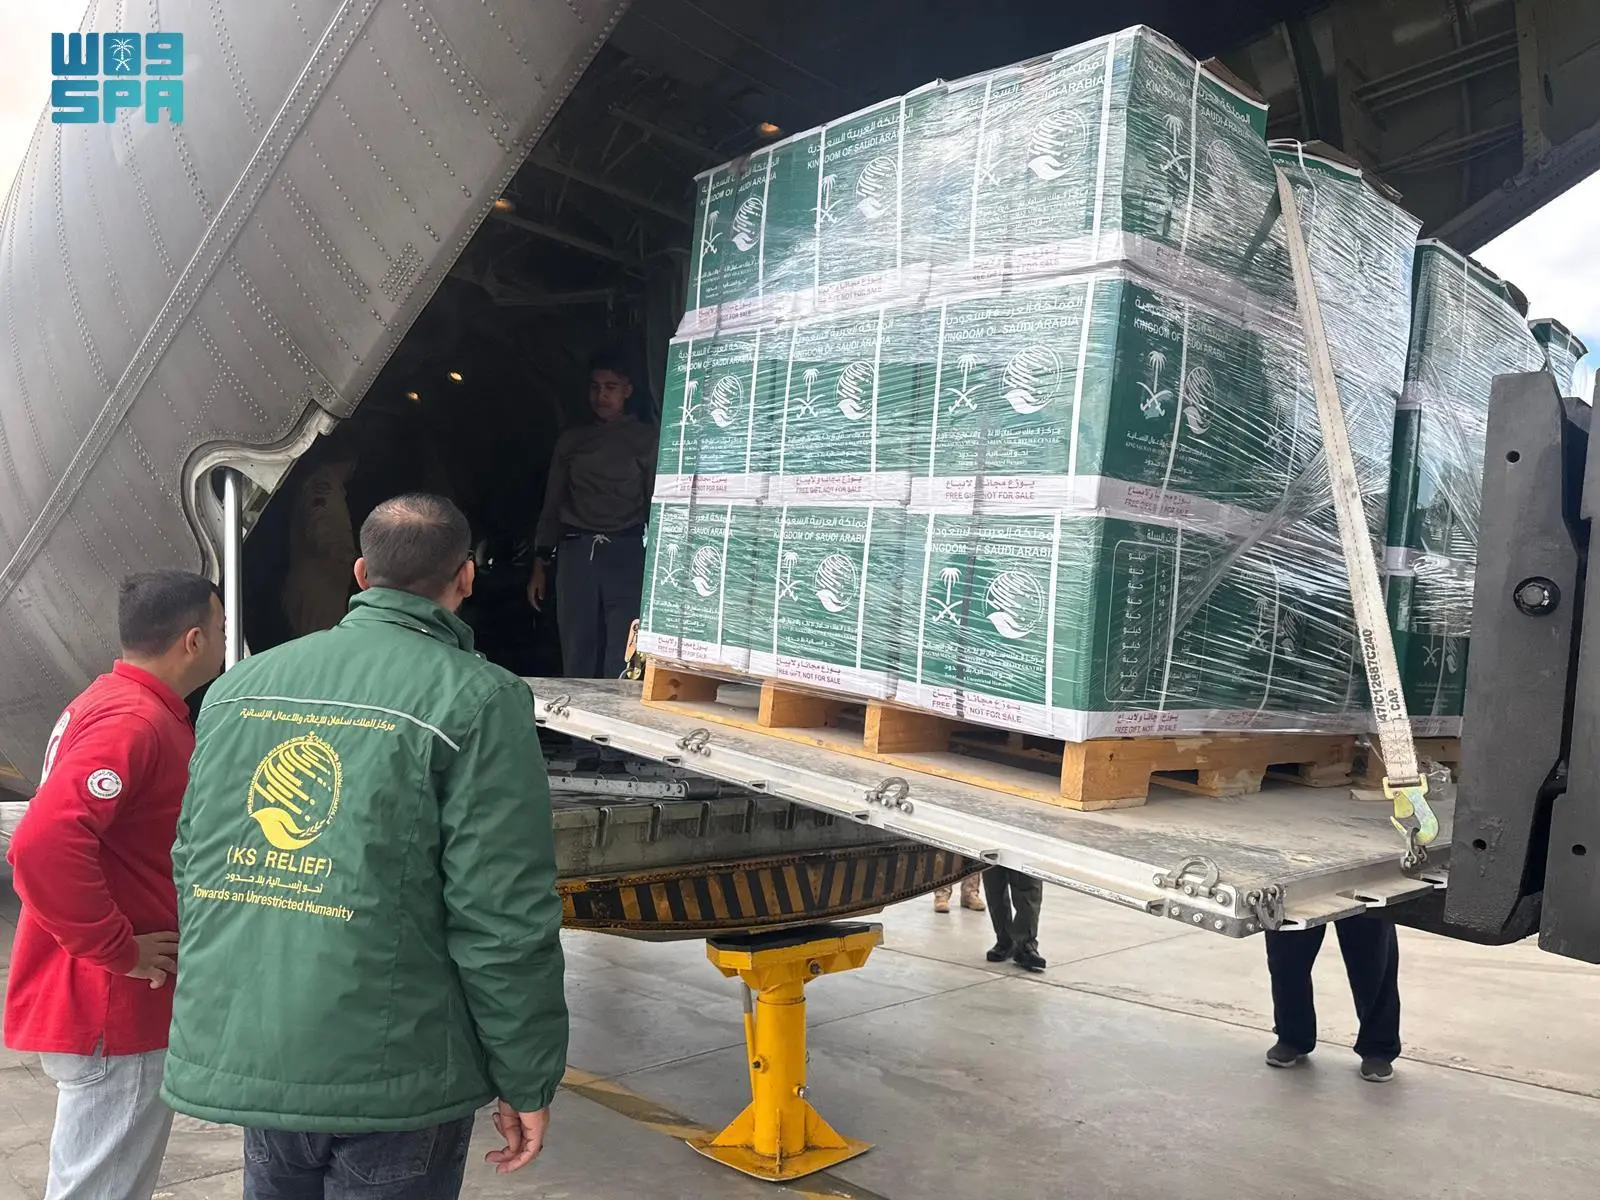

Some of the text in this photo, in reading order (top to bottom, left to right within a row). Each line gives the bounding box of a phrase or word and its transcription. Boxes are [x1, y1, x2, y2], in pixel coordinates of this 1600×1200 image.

[808, 151, 841, 169] KINDOM
[999, 491, 1014, 500] FOR
[1015, 491, 1036, 500] SALE
[802, 671, 815, 680] NOT
[815, 674, 827, 682] FOR
[826, 676, 841, 685] SALE
[1387, 688, 1400, 711] CAP.
[931, 700, 950, 710] FREE
[969, 706, 985, 716] NOT
[986, 710, 1001, 719] FOR
[1001, 713, 1022, 724] SALE
[374, 718, 396, 731] مركز
[227, 845, 333, 878] (KS RELIEF)
[224, 871, 255, 882] حدود
[192, 884, 354, 922] Towards an Unrestricted Humanity
